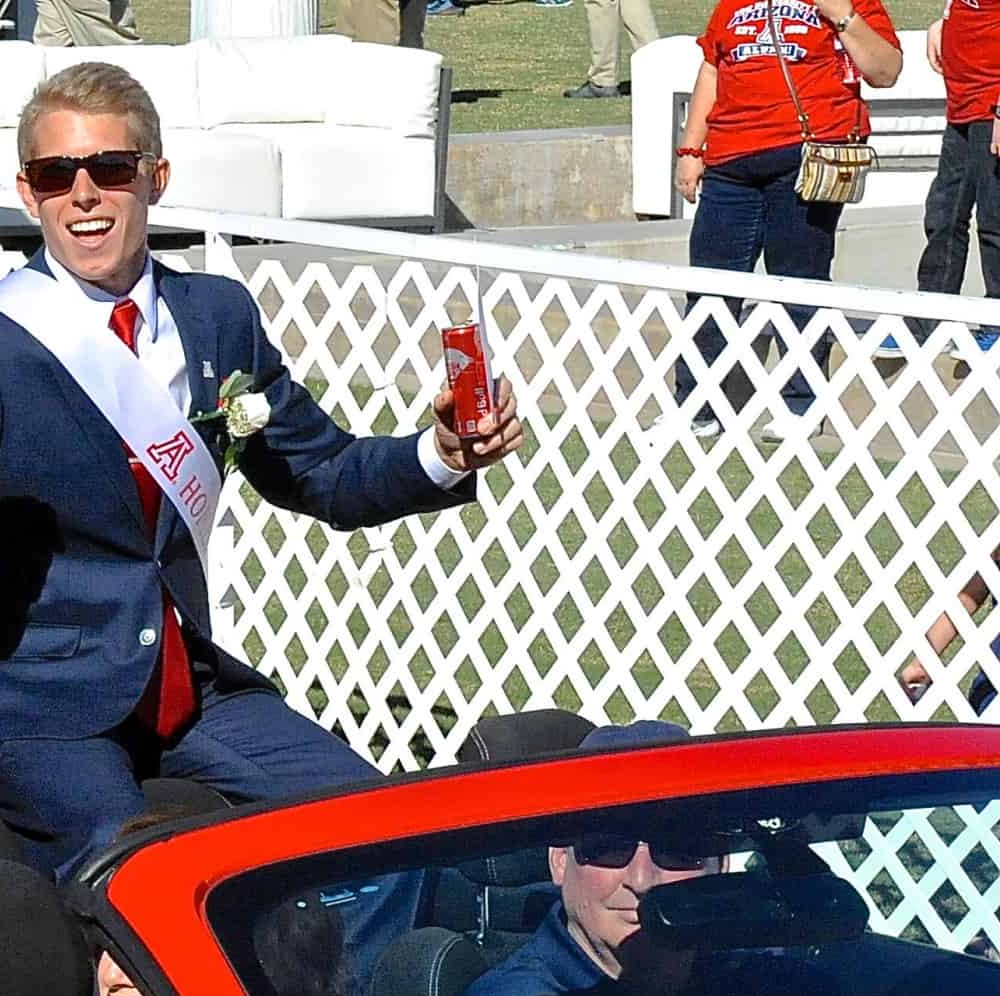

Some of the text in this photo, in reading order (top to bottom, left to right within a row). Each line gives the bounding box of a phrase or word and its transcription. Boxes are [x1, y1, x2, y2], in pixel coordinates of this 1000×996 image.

[729, 5, 820, 27] ARIZONA
[146, 430, 210, 525] A HO
